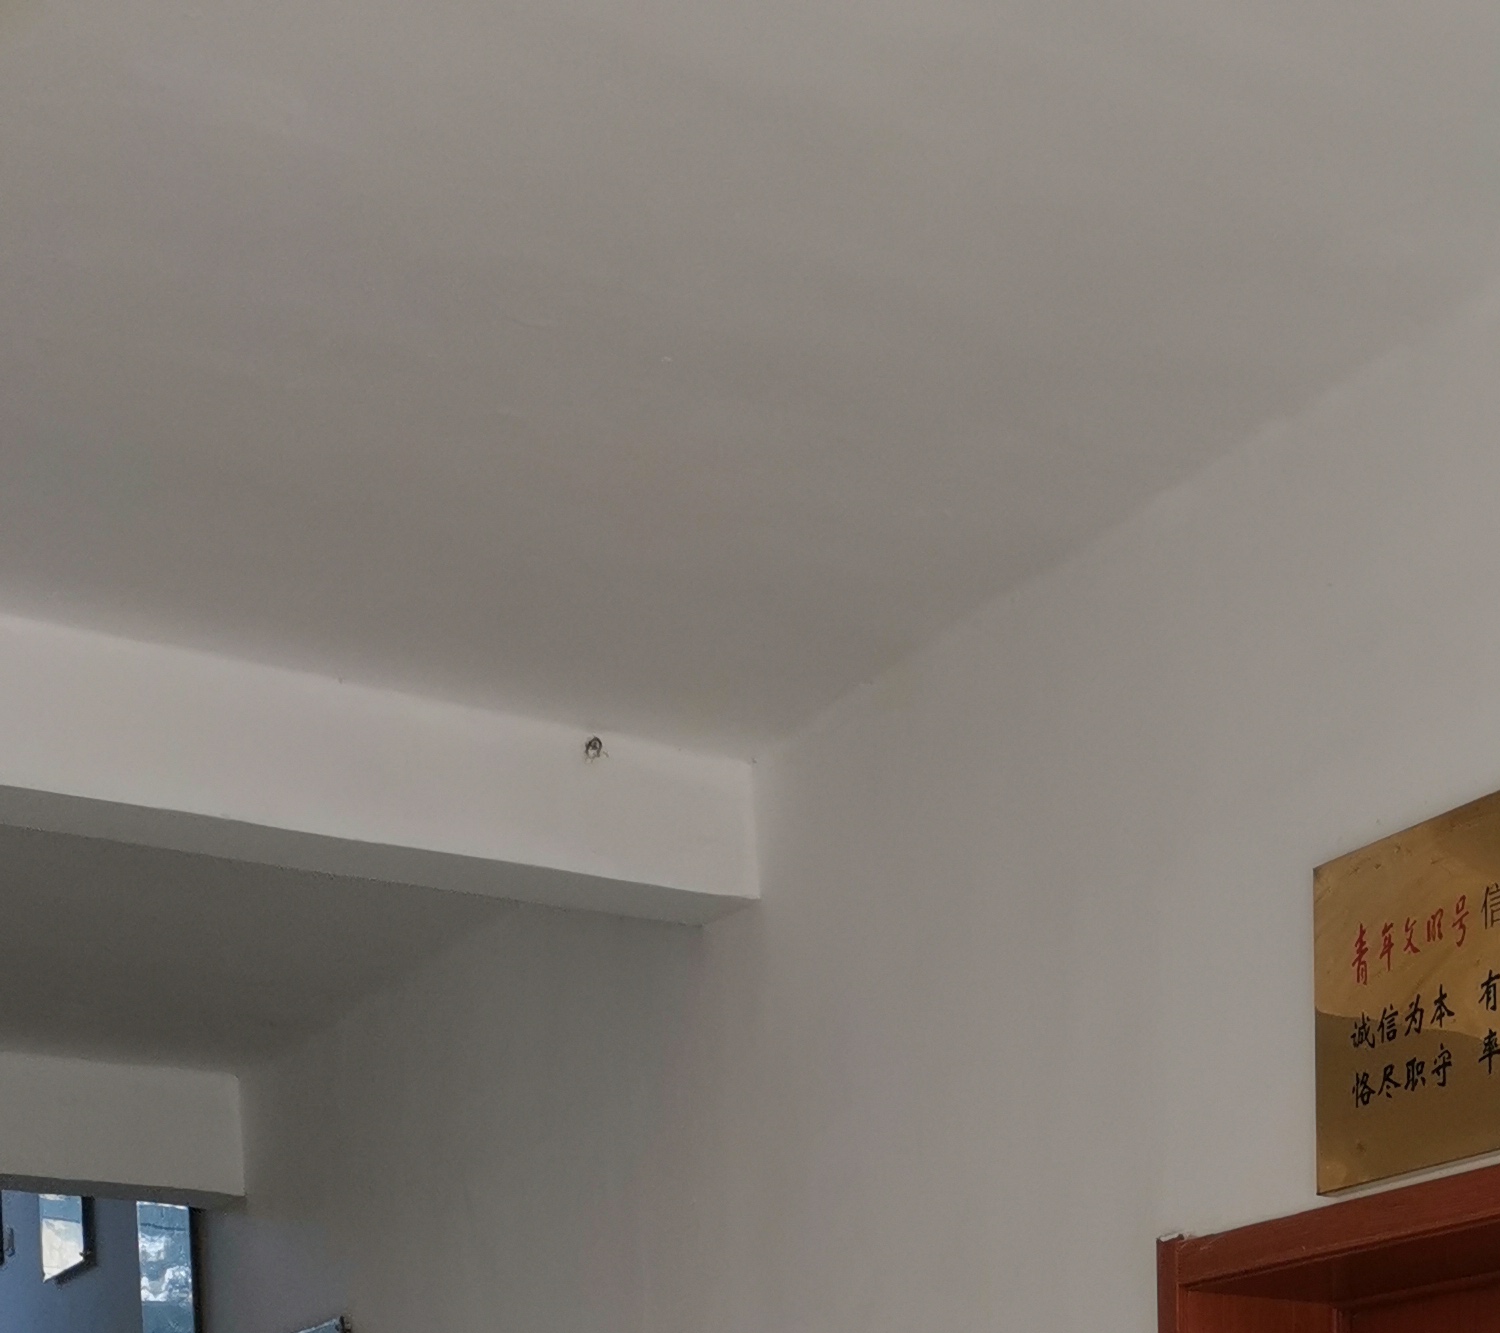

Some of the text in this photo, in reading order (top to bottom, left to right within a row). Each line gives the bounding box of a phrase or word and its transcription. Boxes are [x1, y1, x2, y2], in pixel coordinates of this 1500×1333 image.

[1351, 893, 1471, 986] 青年文明号
[1350, 983, 1456, 1050] 诚信为本
[1351, 1042, 1454, 1109] 恪尽职守
